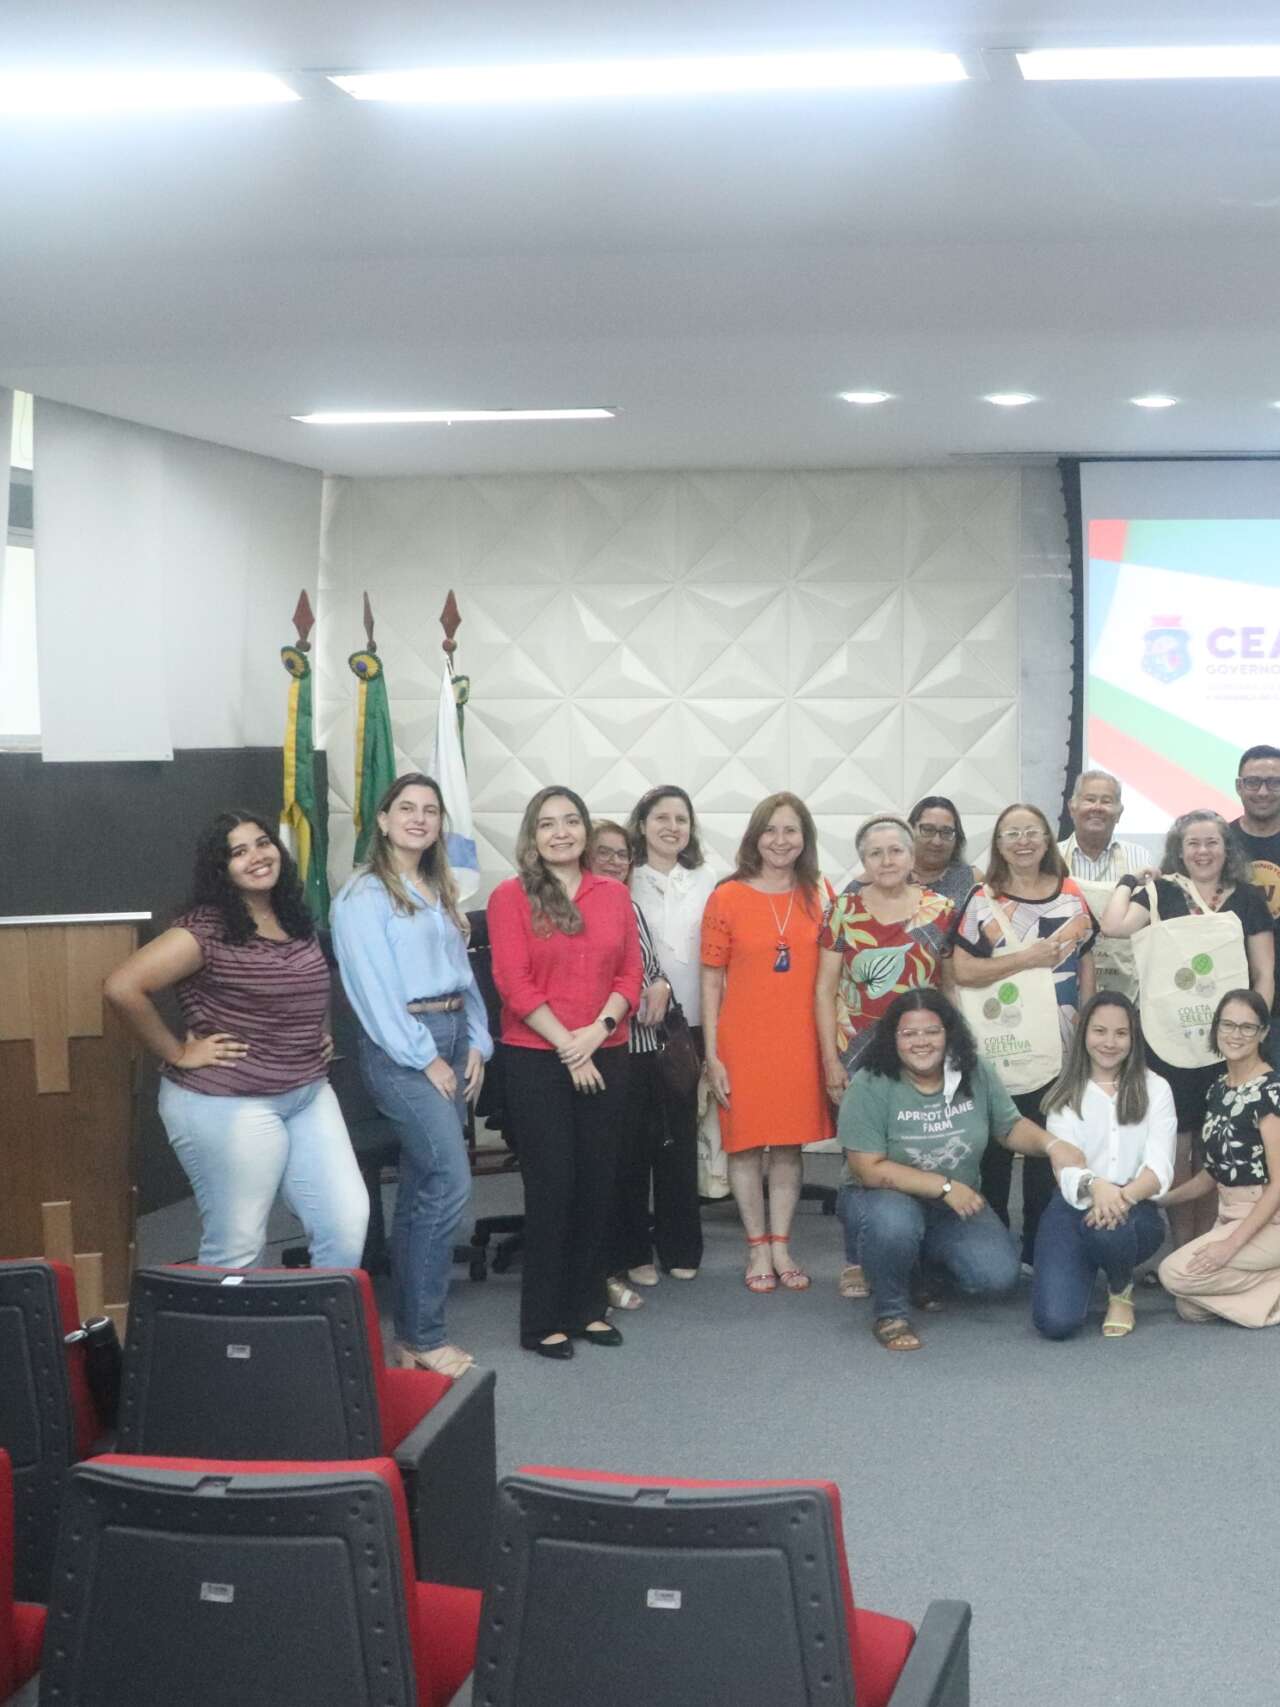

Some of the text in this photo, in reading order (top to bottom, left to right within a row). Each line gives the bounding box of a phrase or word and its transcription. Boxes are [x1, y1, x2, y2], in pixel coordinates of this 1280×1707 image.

[1178, 1004, 1211, 1016] COLETA
[984, 1033, 1016, 1045] COLETA
[897, 1110, 942, 1121] APRICOT
[922, 1119, 953, 1133] FARM
